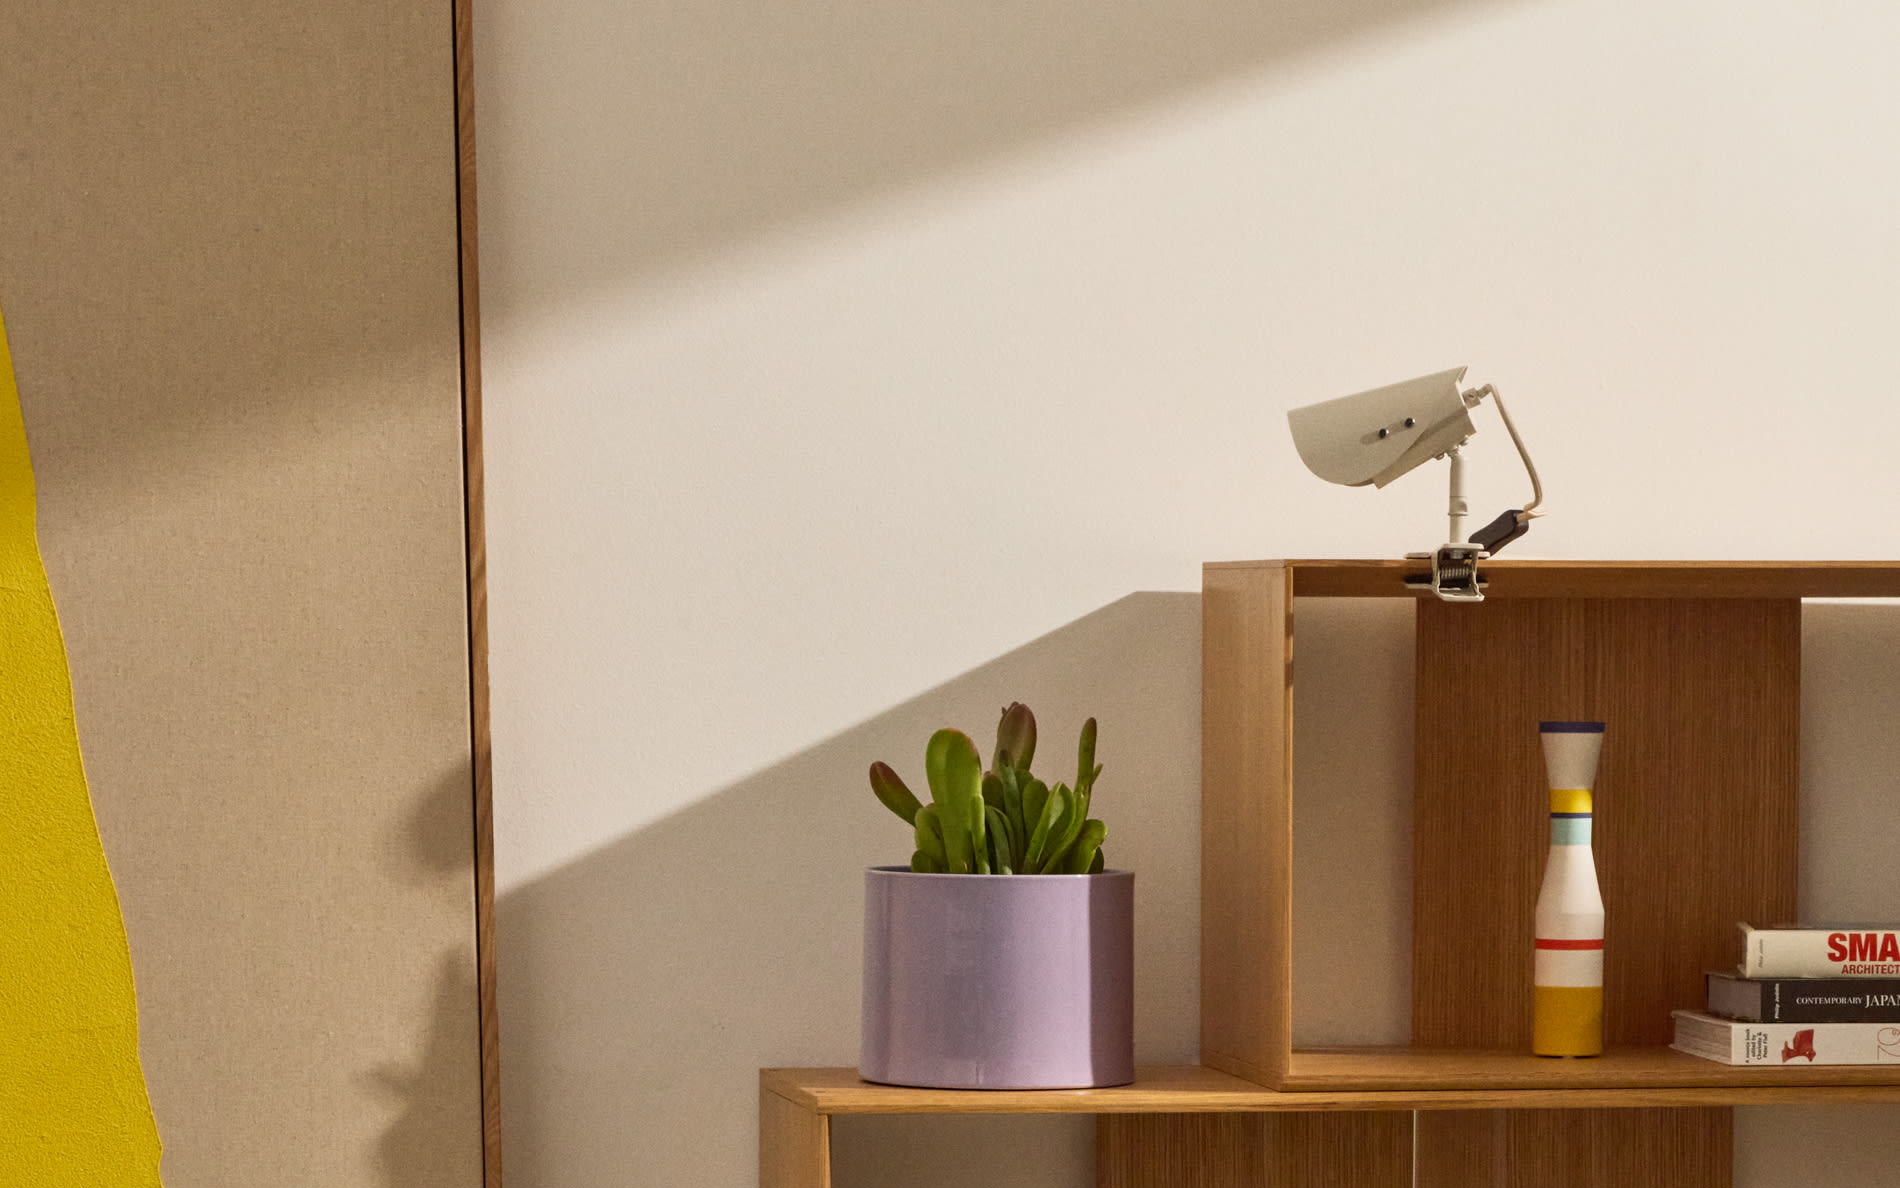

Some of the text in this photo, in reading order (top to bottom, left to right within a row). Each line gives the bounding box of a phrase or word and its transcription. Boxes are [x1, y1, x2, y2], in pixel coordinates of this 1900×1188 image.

[1827, 933, 1900, 962] SMA
[1841, 964, 1900, 975] ARCHITECT
[1796, 996, 1863, 1005] CONTEMPORARY
